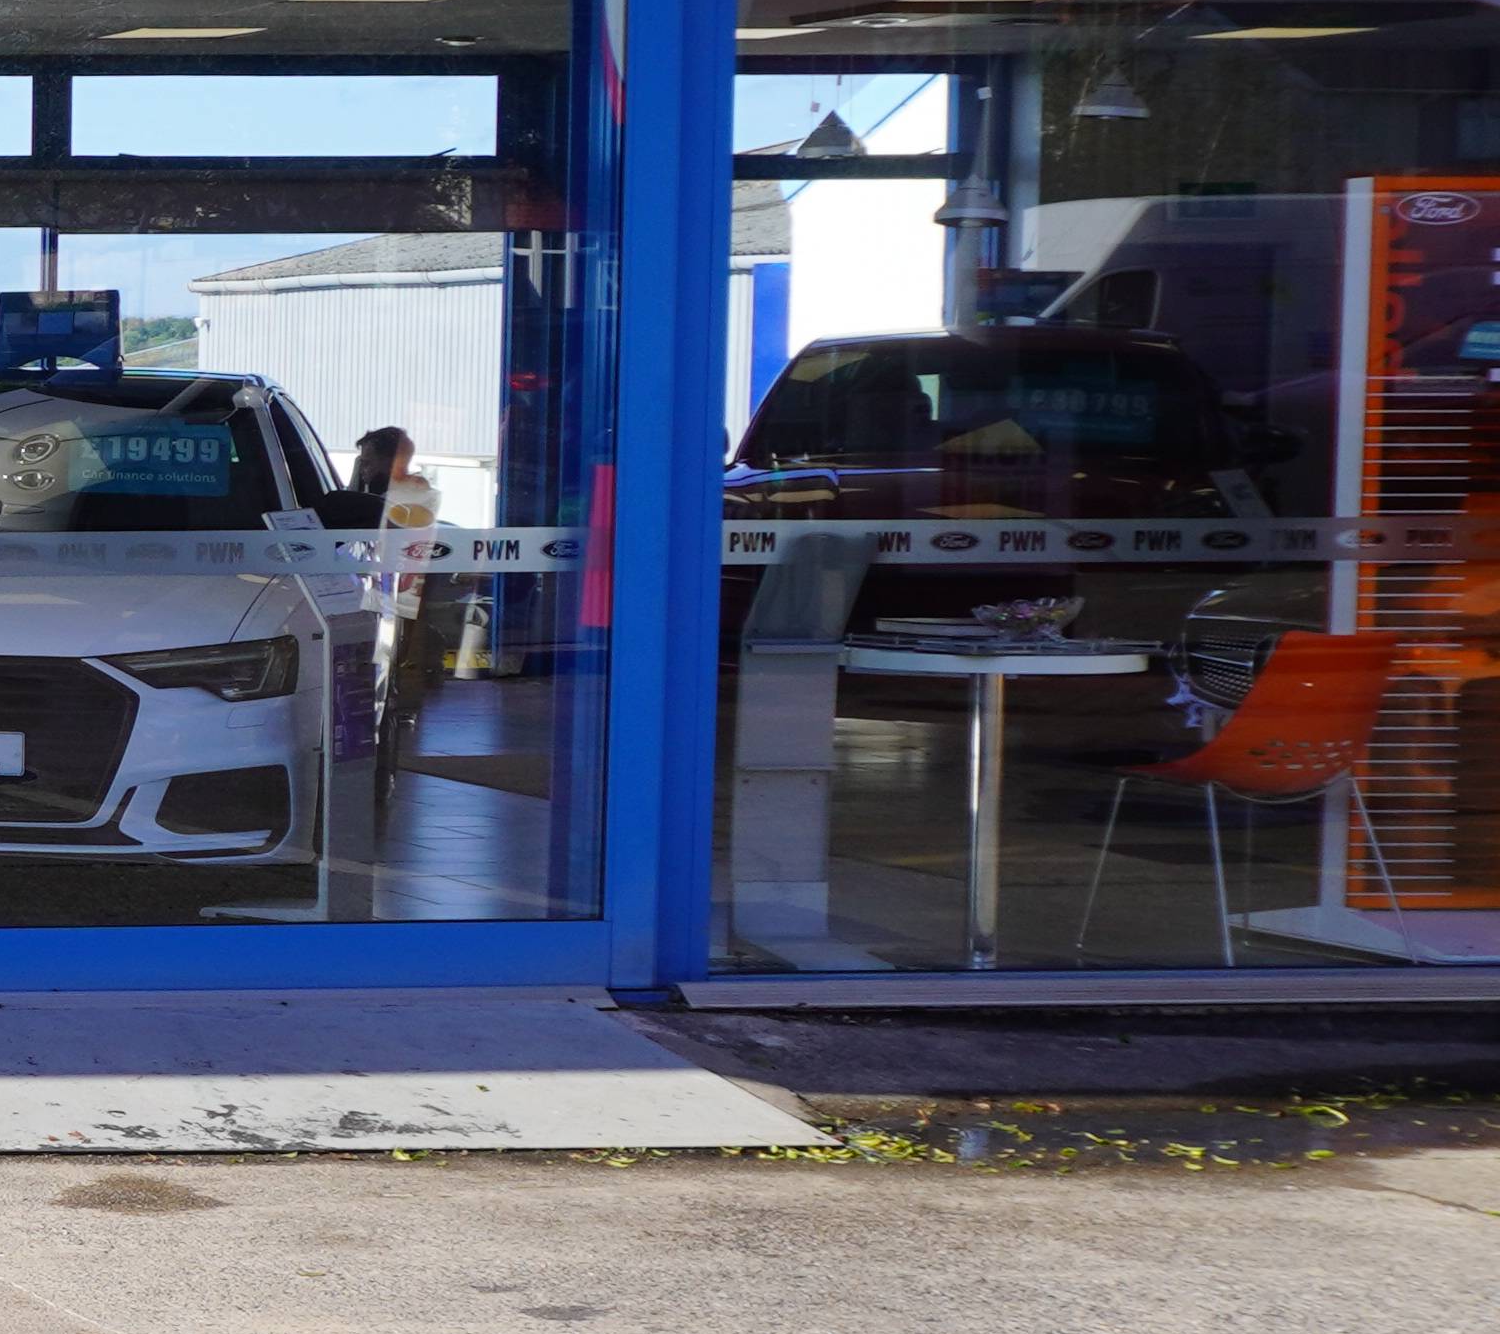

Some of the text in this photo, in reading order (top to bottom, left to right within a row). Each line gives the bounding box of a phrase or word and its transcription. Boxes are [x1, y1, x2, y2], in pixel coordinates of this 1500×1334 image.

[1409, 195, 1466, 220] Ford
[158, 471, 217, 484] solutions
[195, 542, 245, 564] PWM
[472, 539, 521, 562] PWM
[729, 531, 777, 553] PWM
[1000, 531, 1047, 552] PWM
[1133, 530, 1182, 552] PWM
